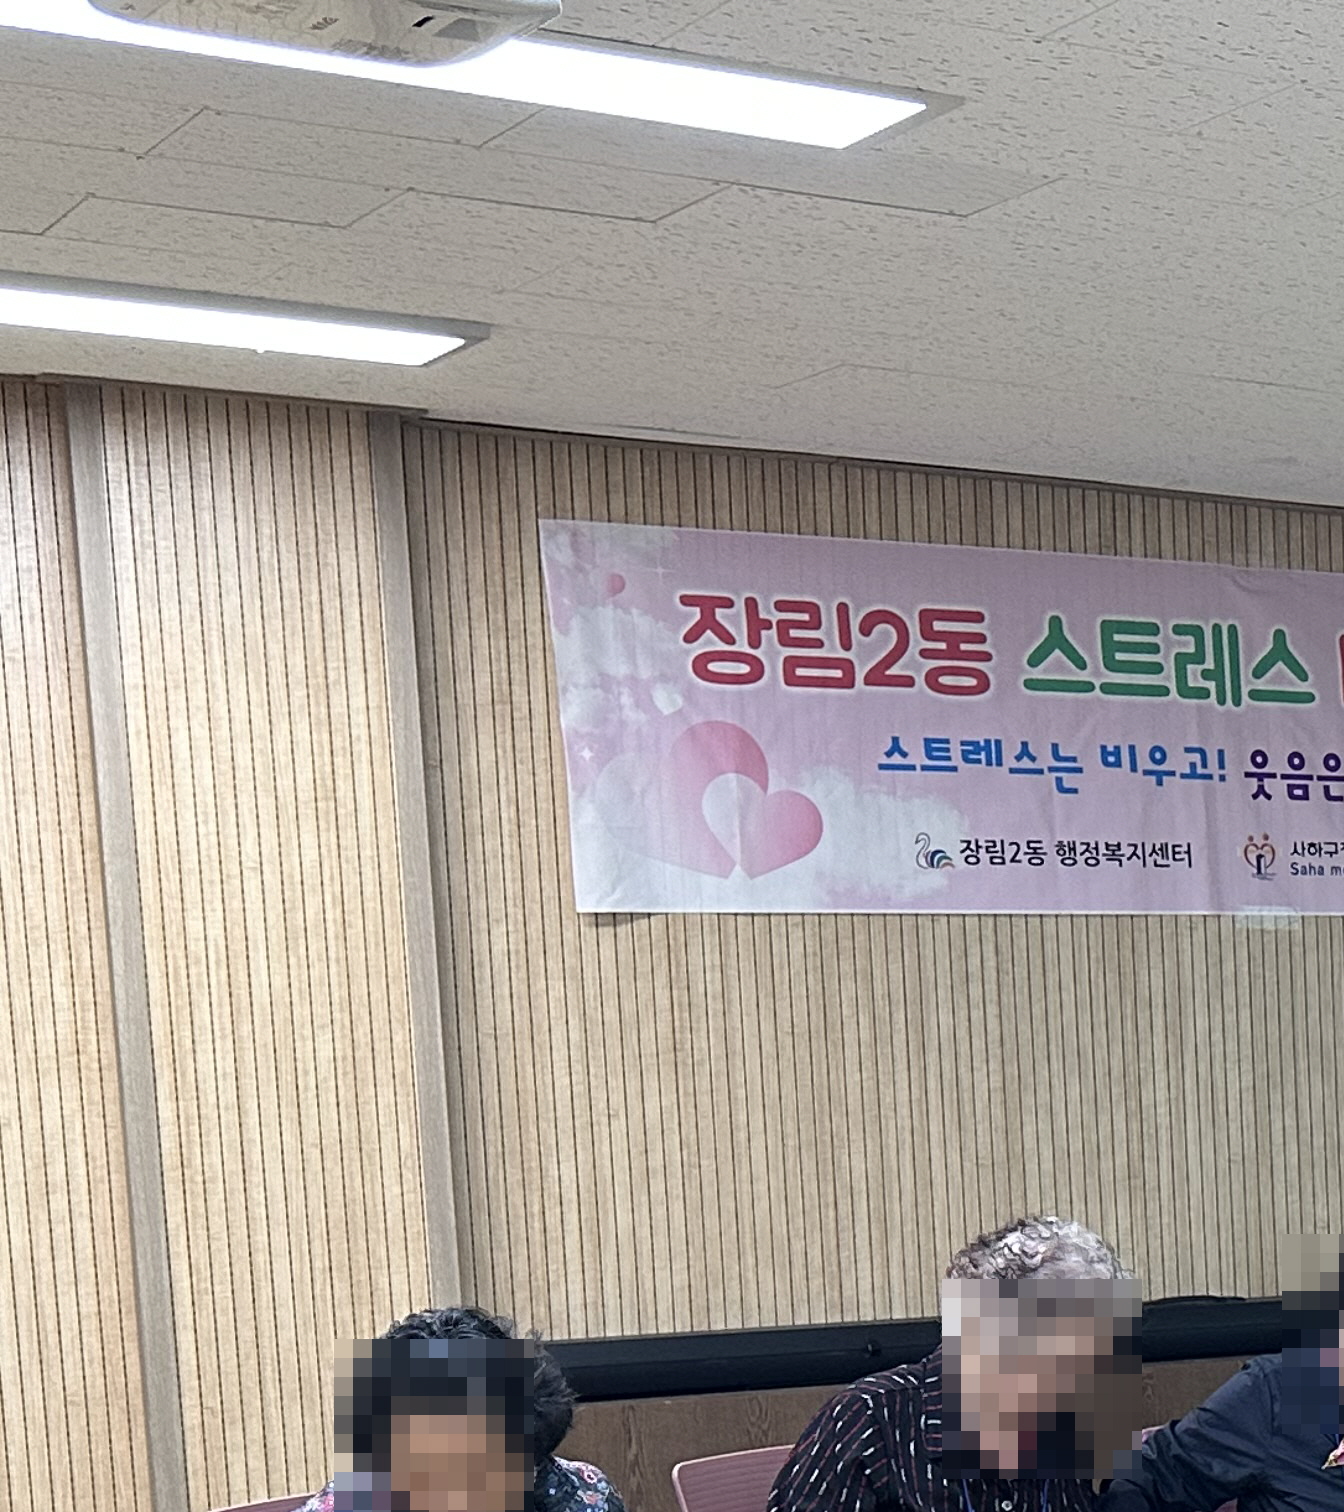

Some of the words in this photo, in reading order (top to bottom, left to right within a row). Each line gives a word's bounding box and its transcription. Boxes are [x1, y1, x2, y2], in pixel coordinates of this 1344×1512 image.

[677, 594, 994, 697] 장림2동
[1022, 614, 1316, 709] 스트레스
[877, 736, 1084, 795] 스트레스는
[1099, 743, 1227, 788] 비우고!
[959, 838, 1048, 867] 장림2동
[1054, 839, 1193, 869] 행정복지센터
[1290, 861, 1325, 877] Saha
